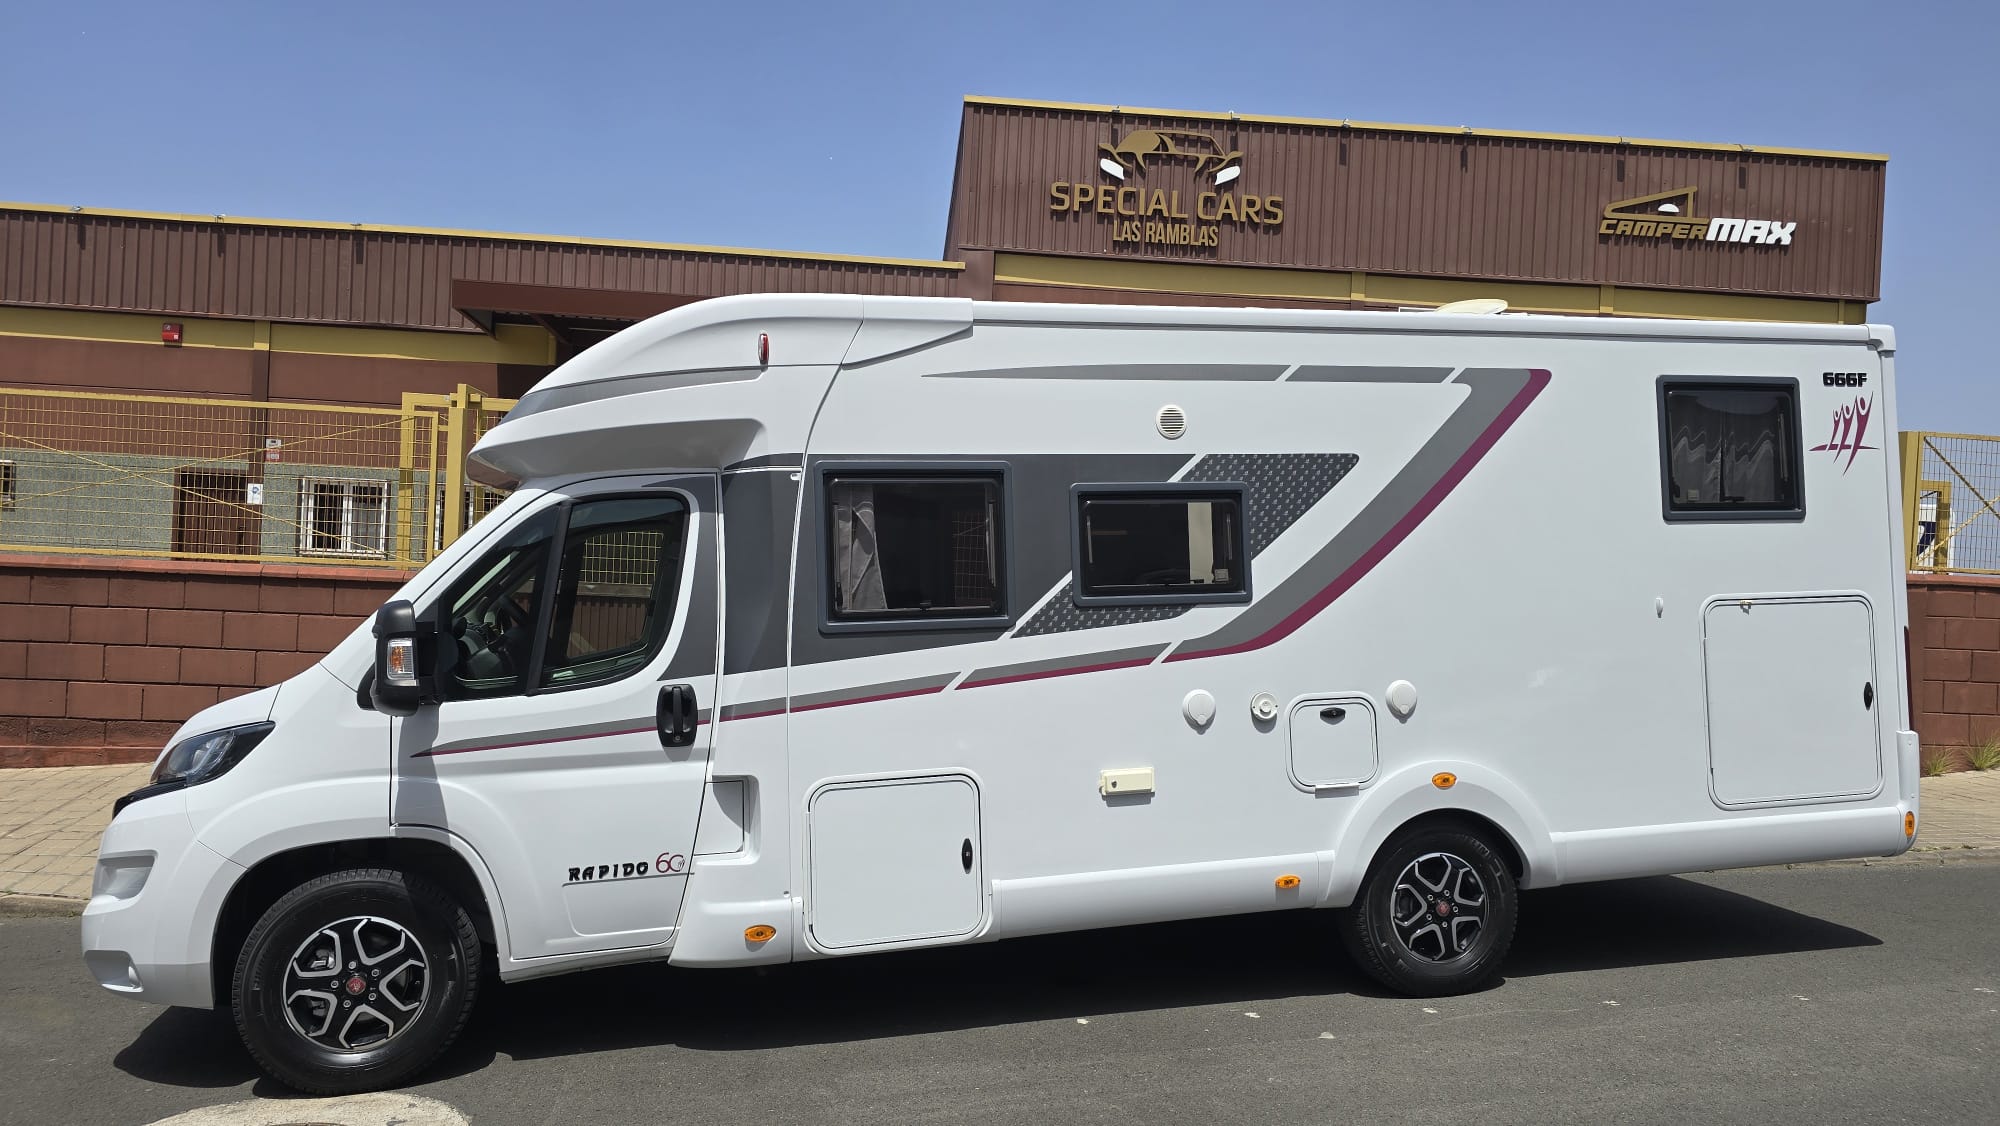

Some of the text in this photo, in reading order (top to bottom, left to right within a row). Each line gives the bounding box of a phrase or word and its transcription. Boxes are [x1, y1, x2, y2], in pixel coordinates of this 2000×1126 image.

[1050, 181, 1284, 225] SPECIAL CARS
[1112, 220, 1219, 247] LAS RAMBLAS
[1822, 372, 1868, 387] 666F
[568, 861, 649, 881] RAPIDO
